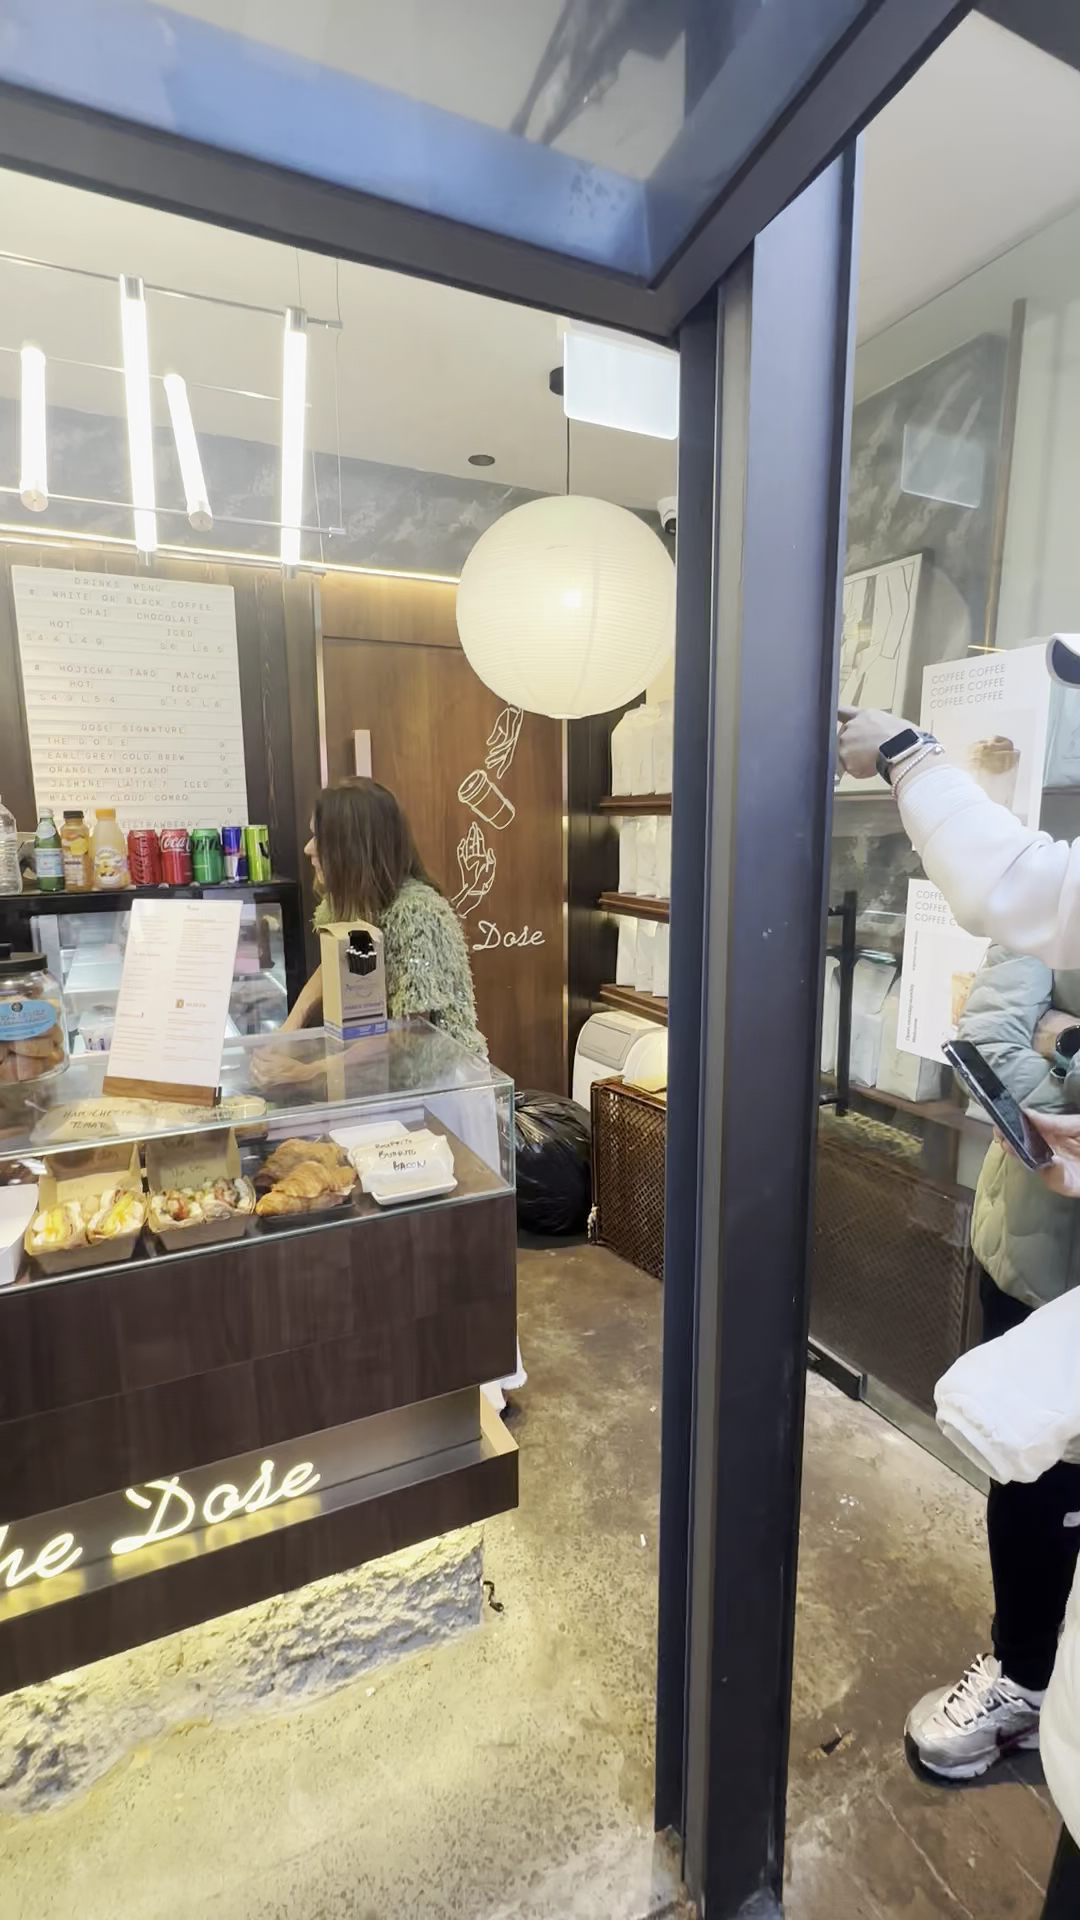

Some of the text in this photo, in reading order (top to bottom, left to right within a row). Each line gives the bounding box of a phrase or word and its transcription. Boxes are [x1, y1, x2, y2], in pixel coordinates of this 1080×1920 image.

[74, 577, 160, 592] DRINKS MENU
[52, 590, 88, 600] WHITE
[102, 594, 116, 602] OR
[127, 596, 161, 607] BLACK
[171, 600, 212, 611] COFFEE
[80, 607, 198, 624] CHAI CHOCOLATE
[49, 620, 71, 628] HOT
[168, 628, 192, 637] ICED
[60, 665, 111, 674] HOJICHA
[128, 668, 156, 677] TARO
[176, 672, 216, 680] MATCHA
[932, 664, 1006, 684] COFFEE COFFEE
[171, 685, 197, 693] ICED
[931, 677, 1004, 696] COFFEE COFFEE
[930, 690, 1004, 709] COFFEE COFFEE
[81, 724, 184, 734] DOSE SIGNATURE
[48, 736, 67, 744] THE
[86, 752, 113, 760] GREY
[158, 753, 185, 761] BREW
[52, 780, 101, 788] JASMINE
[118, 779, 152, 788] LATTE
[916, 890, 944, 900] COFFE
[915, 901, 947, 913] COFFEE
[914, 912, 946, 925] COFFEE
[472, 920, 546, 951] Dose
[393, 1160, 426, 1171] BACON
[0, 1459, 322, 1588] he Dose
